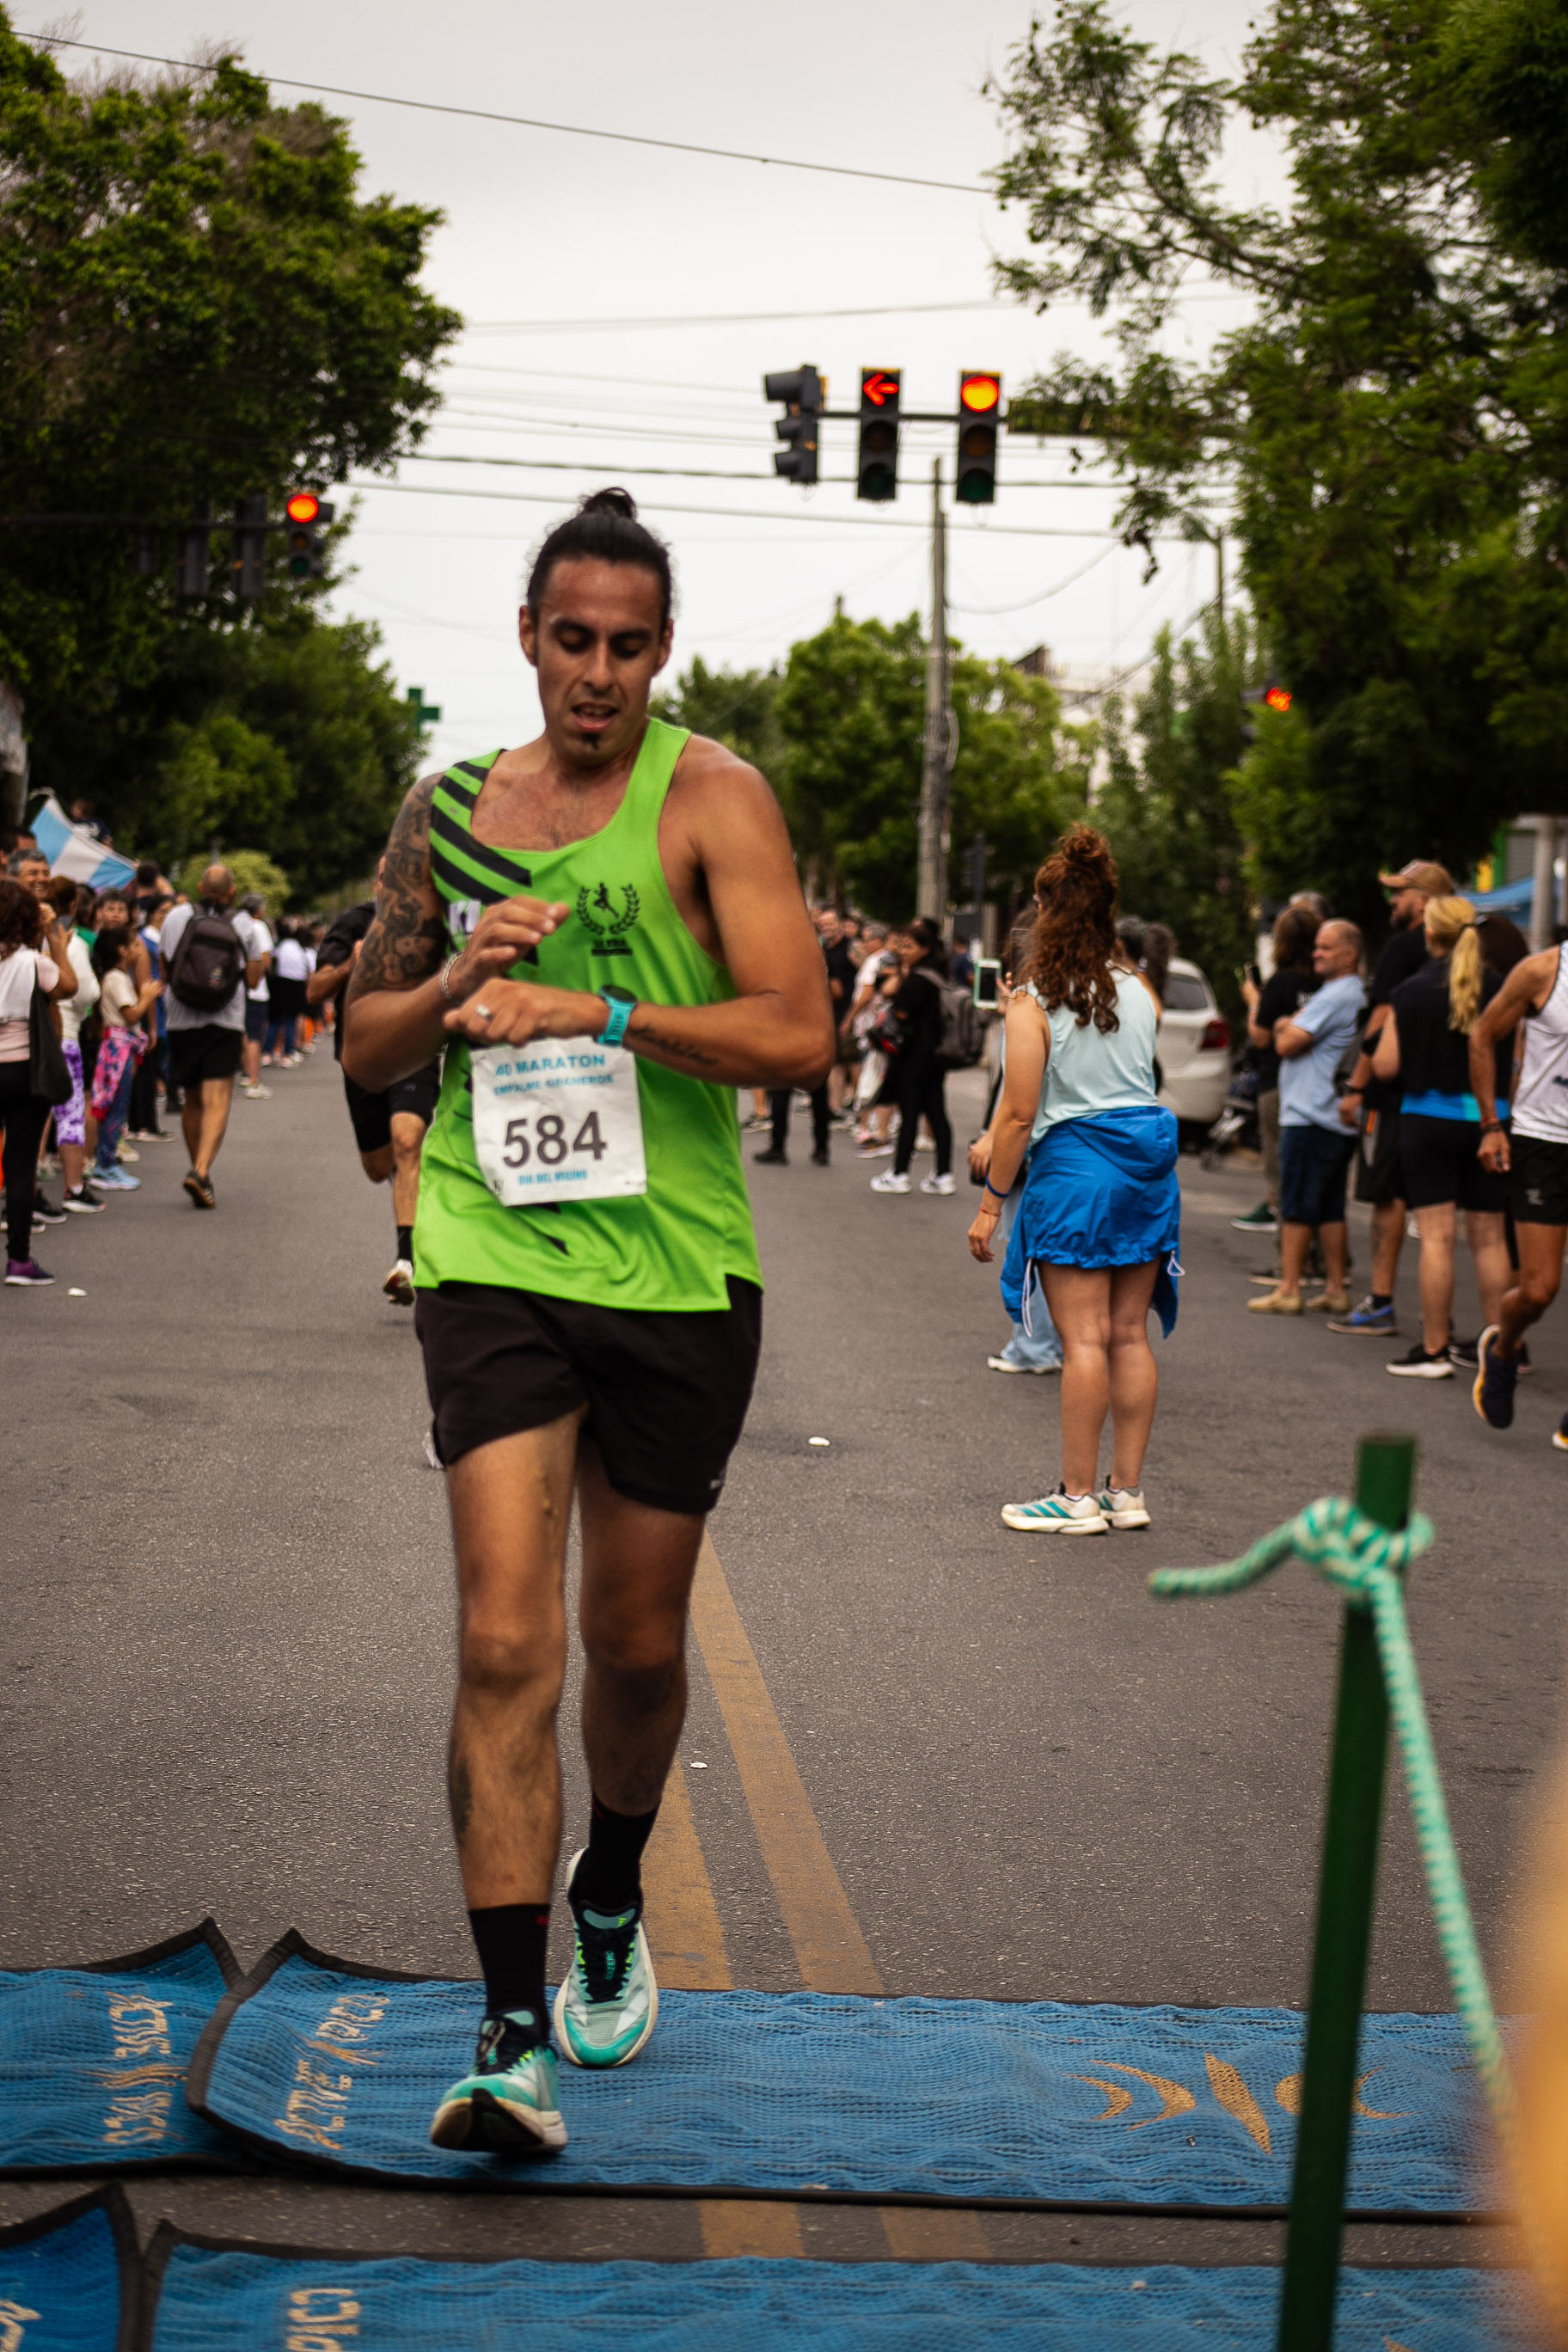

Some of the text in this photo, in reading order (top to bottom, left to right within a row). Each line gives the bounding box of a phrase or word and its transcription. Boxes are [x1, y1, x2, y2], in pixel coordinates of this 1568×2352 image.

[516, 1054, 605, 1074] MARATON
[502, 1111, 608, 1169] 584
[273, 2059, 352, 2150] ACTIVE
[315, 1994, 391, 2043] PICO
